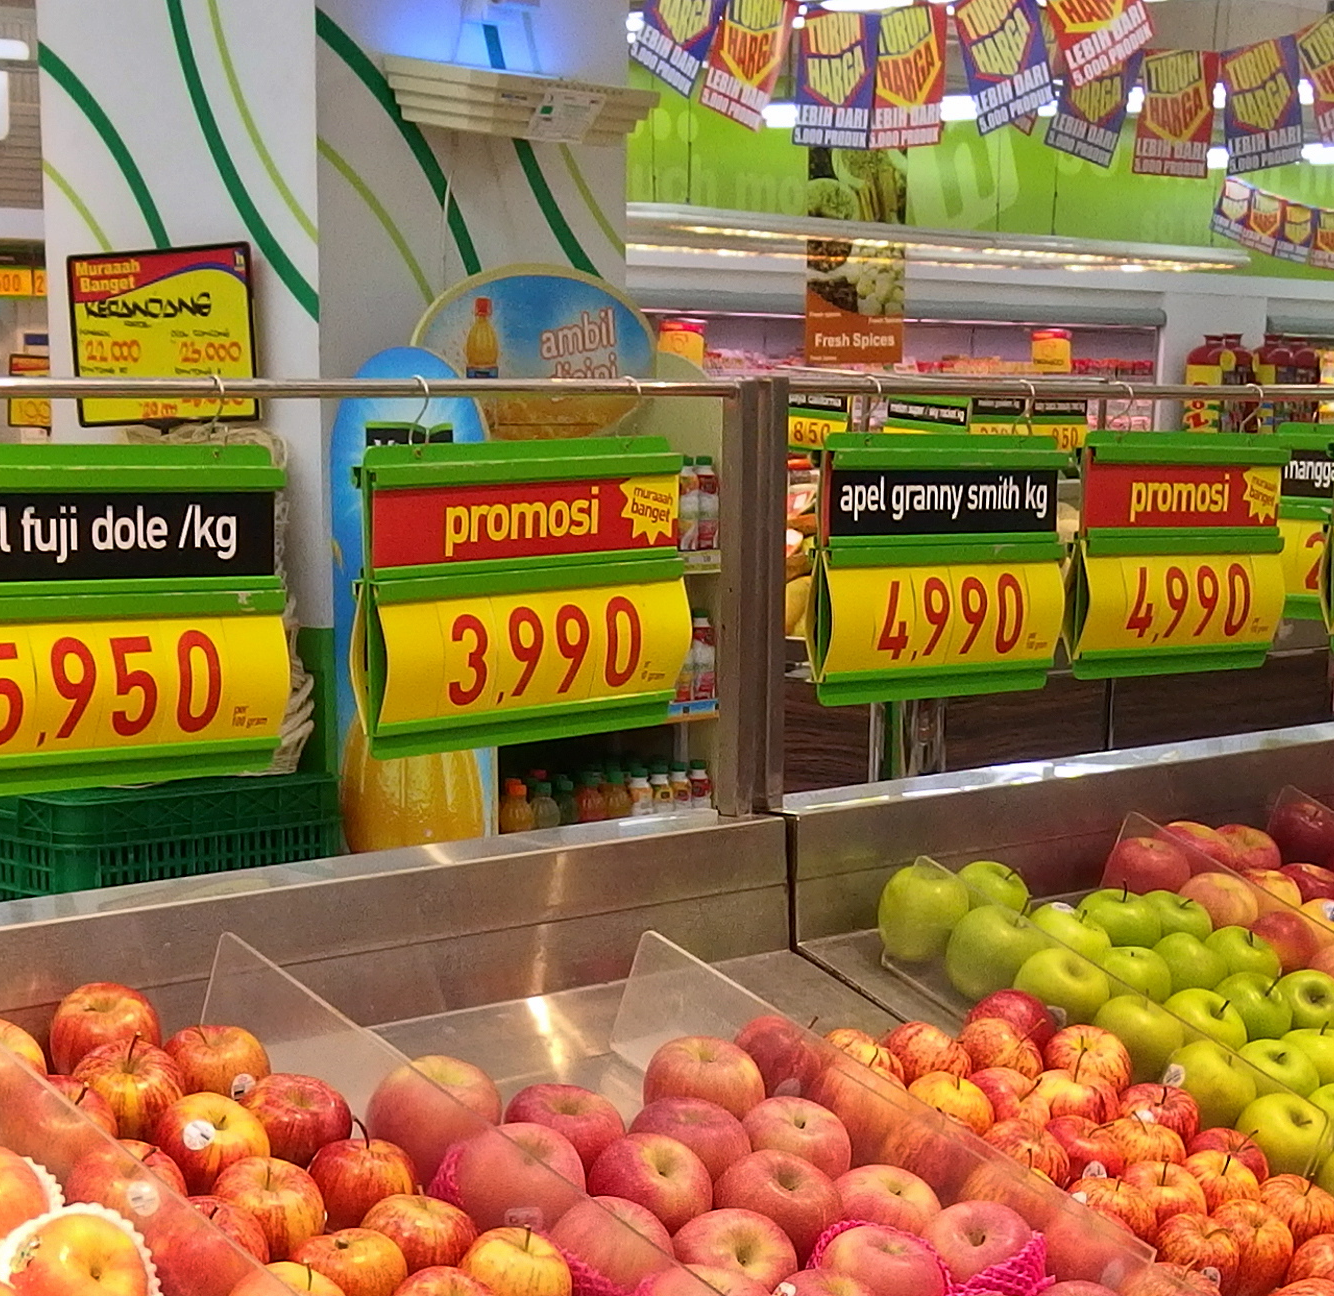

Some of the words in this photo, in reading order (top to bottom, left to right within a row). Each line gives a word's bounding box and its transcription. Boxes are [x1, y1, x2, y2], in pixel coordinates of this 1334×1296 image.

[635, 22, 672, 58] LEBIH
[670, 37, 701, 79] DARI
[726, 25, 781, 82] HARGA
[806, 13, 862, 56] TURUN
[878, 5, 932, 55] TURUN
[970, 7, 1032, 76] HARGA
[1064, 26, 1111, 71] LEBIH
[1110, 0, 1147, 45] DARI
[1072, 54, 1111, 88] 5.000
[1109, 21, 1154, 66] PRODUK
[655, 54, 694, 96] PRODUK
[707, 67, 741, 98] LEBIH
[741, 79, 770, 109] DARI
[806, 44, 865, 106] HARGA
[878, 38, 937, 103] HARGA
[974, 78, 1013, 114] LEBIH
[1014, 61, 1051, 94] DARI
[1148, 51, 1202, 94] TURUN
[1225, 40, 1282, 92] TURUN
[727, 97, 764, 131] PRODUK
[796, 104, 833, 129] LEBIH
[834, 106, 869, 130] DARI
[871, 104, 908, 129] LEBIH
[909, 102, 942, 125] DARI
[978, 110, 1009, 134] 5.000
[1009, 84, 1055, 119] PRODUK
[1150, 85, 1204, 138] HARGA
[1231, 72, 1292, 131] HARGA
[793, 129, 825, 148] 5.000
[826, 129, 868, 149] PRODUK
[869, 129, 899, 149] 5.000
[899, 125, 939, 147] PRODUK
[1051, 112, 1087, 140] LEBIH
[1086, 122, 1118, 149] DARI
[1074, 139, 1112, 168] PRODUK
[1135, 136, 1171, 158] LEBIH
[1172, 139, 1208, 161] DARI
[1227, 131, 1267, 156] LEBIH
[1268, 123, 1302, 151] DARI
[1228, 154, 1259, 175] 5.000
[80, 275, 136, 294] Banget
[540, 306, 616, 360] ambil
[814, 332, 851, 347] Fresh
[852, 332, 896, 349] Spices
[443, 485, 600, 558] promosi
[630, 497, 671, 525] banget
[632, 486, 675, 509] muraaah
[840, 476, 886, 521] apel
[891, 481, 964, 521] granny
[966, 474, 1021, 511] smith
[1024, 474, 1049, 519] kg
[1129, 473, 1231, 523] promosi
[21, 504, 80, 565] fuji
[91, 503, 170, 553] dole
[177, 502, 239, 561] /kg
[876, 572, 1025, 662] 4,990
[1125, 562, 1252, 643] 4,990
[447, 595, 643, 707] 3,990
